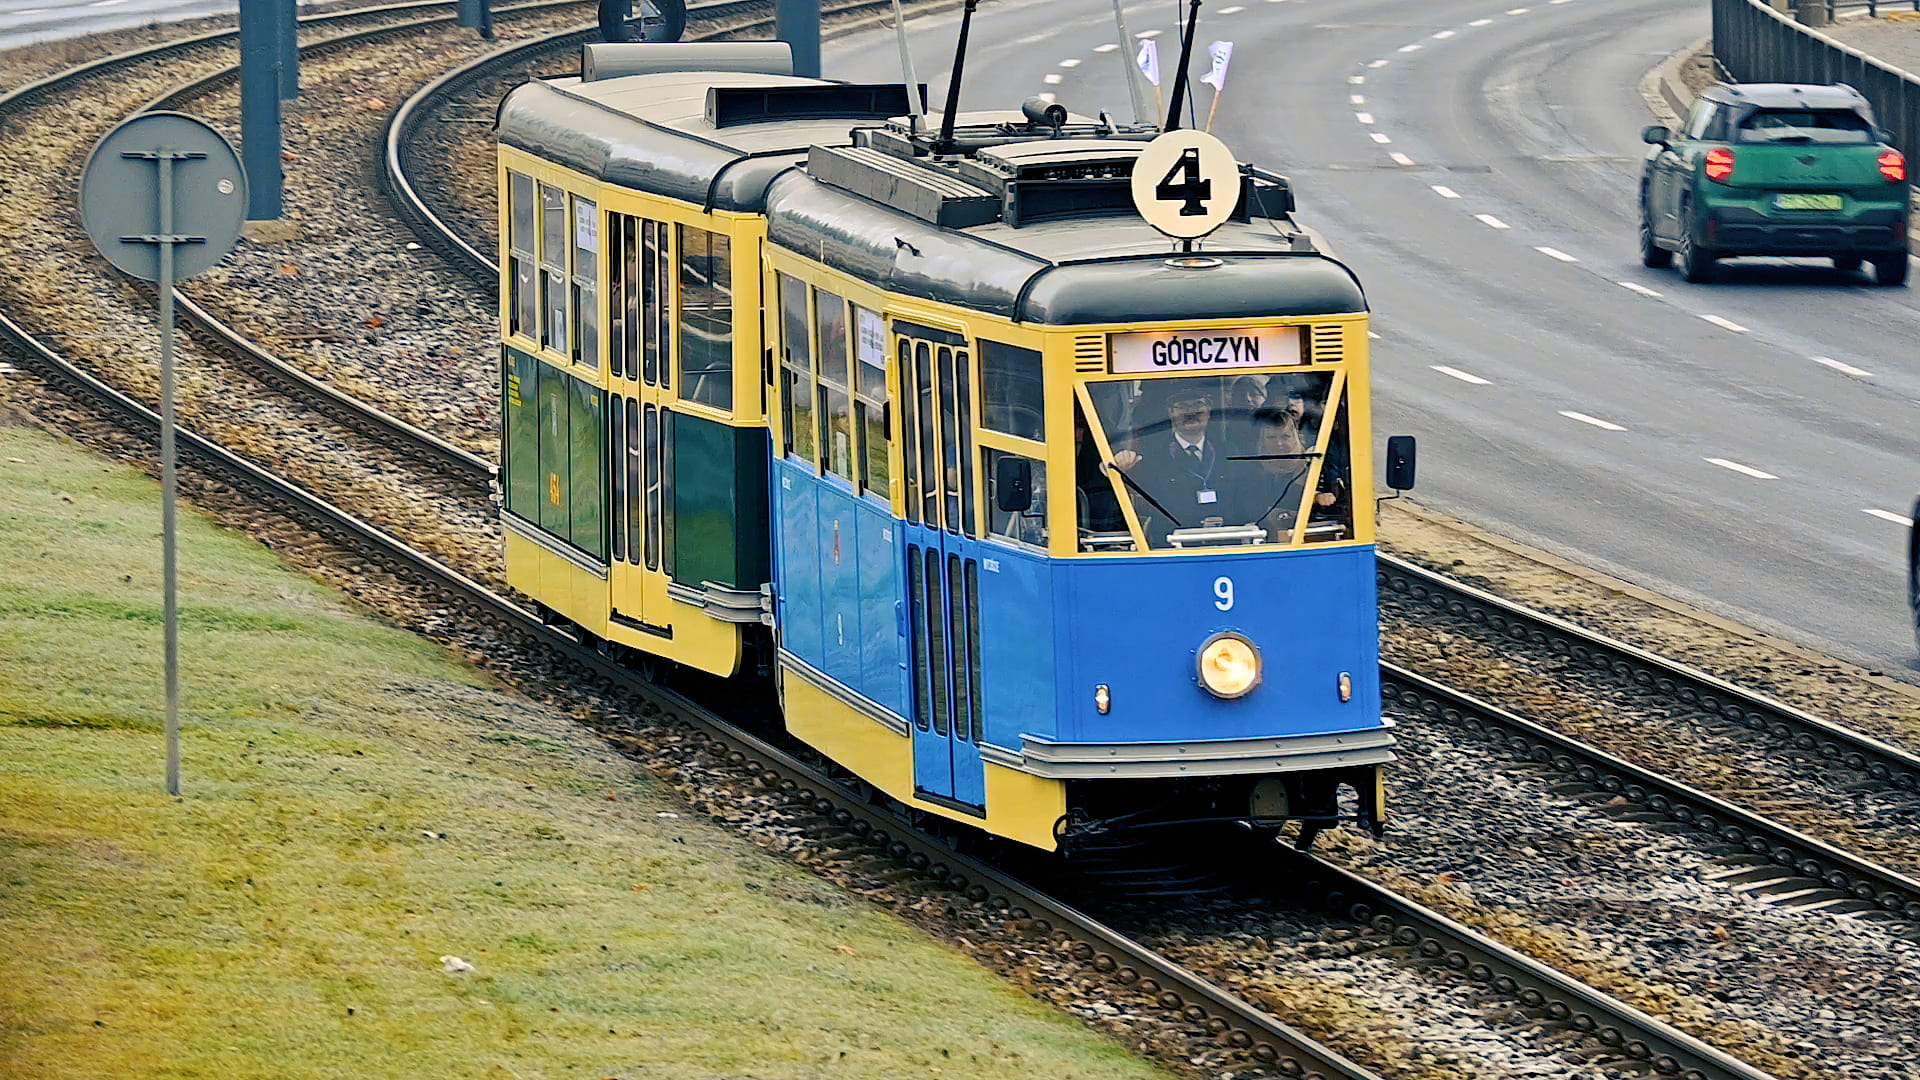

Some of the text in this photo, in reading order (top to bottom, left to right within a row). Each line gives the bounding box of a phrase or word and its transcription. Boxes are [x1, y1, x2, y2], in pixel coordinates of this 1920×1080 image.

[1156, 147, 1211, 216] 4
[1152, 335, 1259, 366] GÓRCZYN
[1213, 576, 1234, 611] 9
